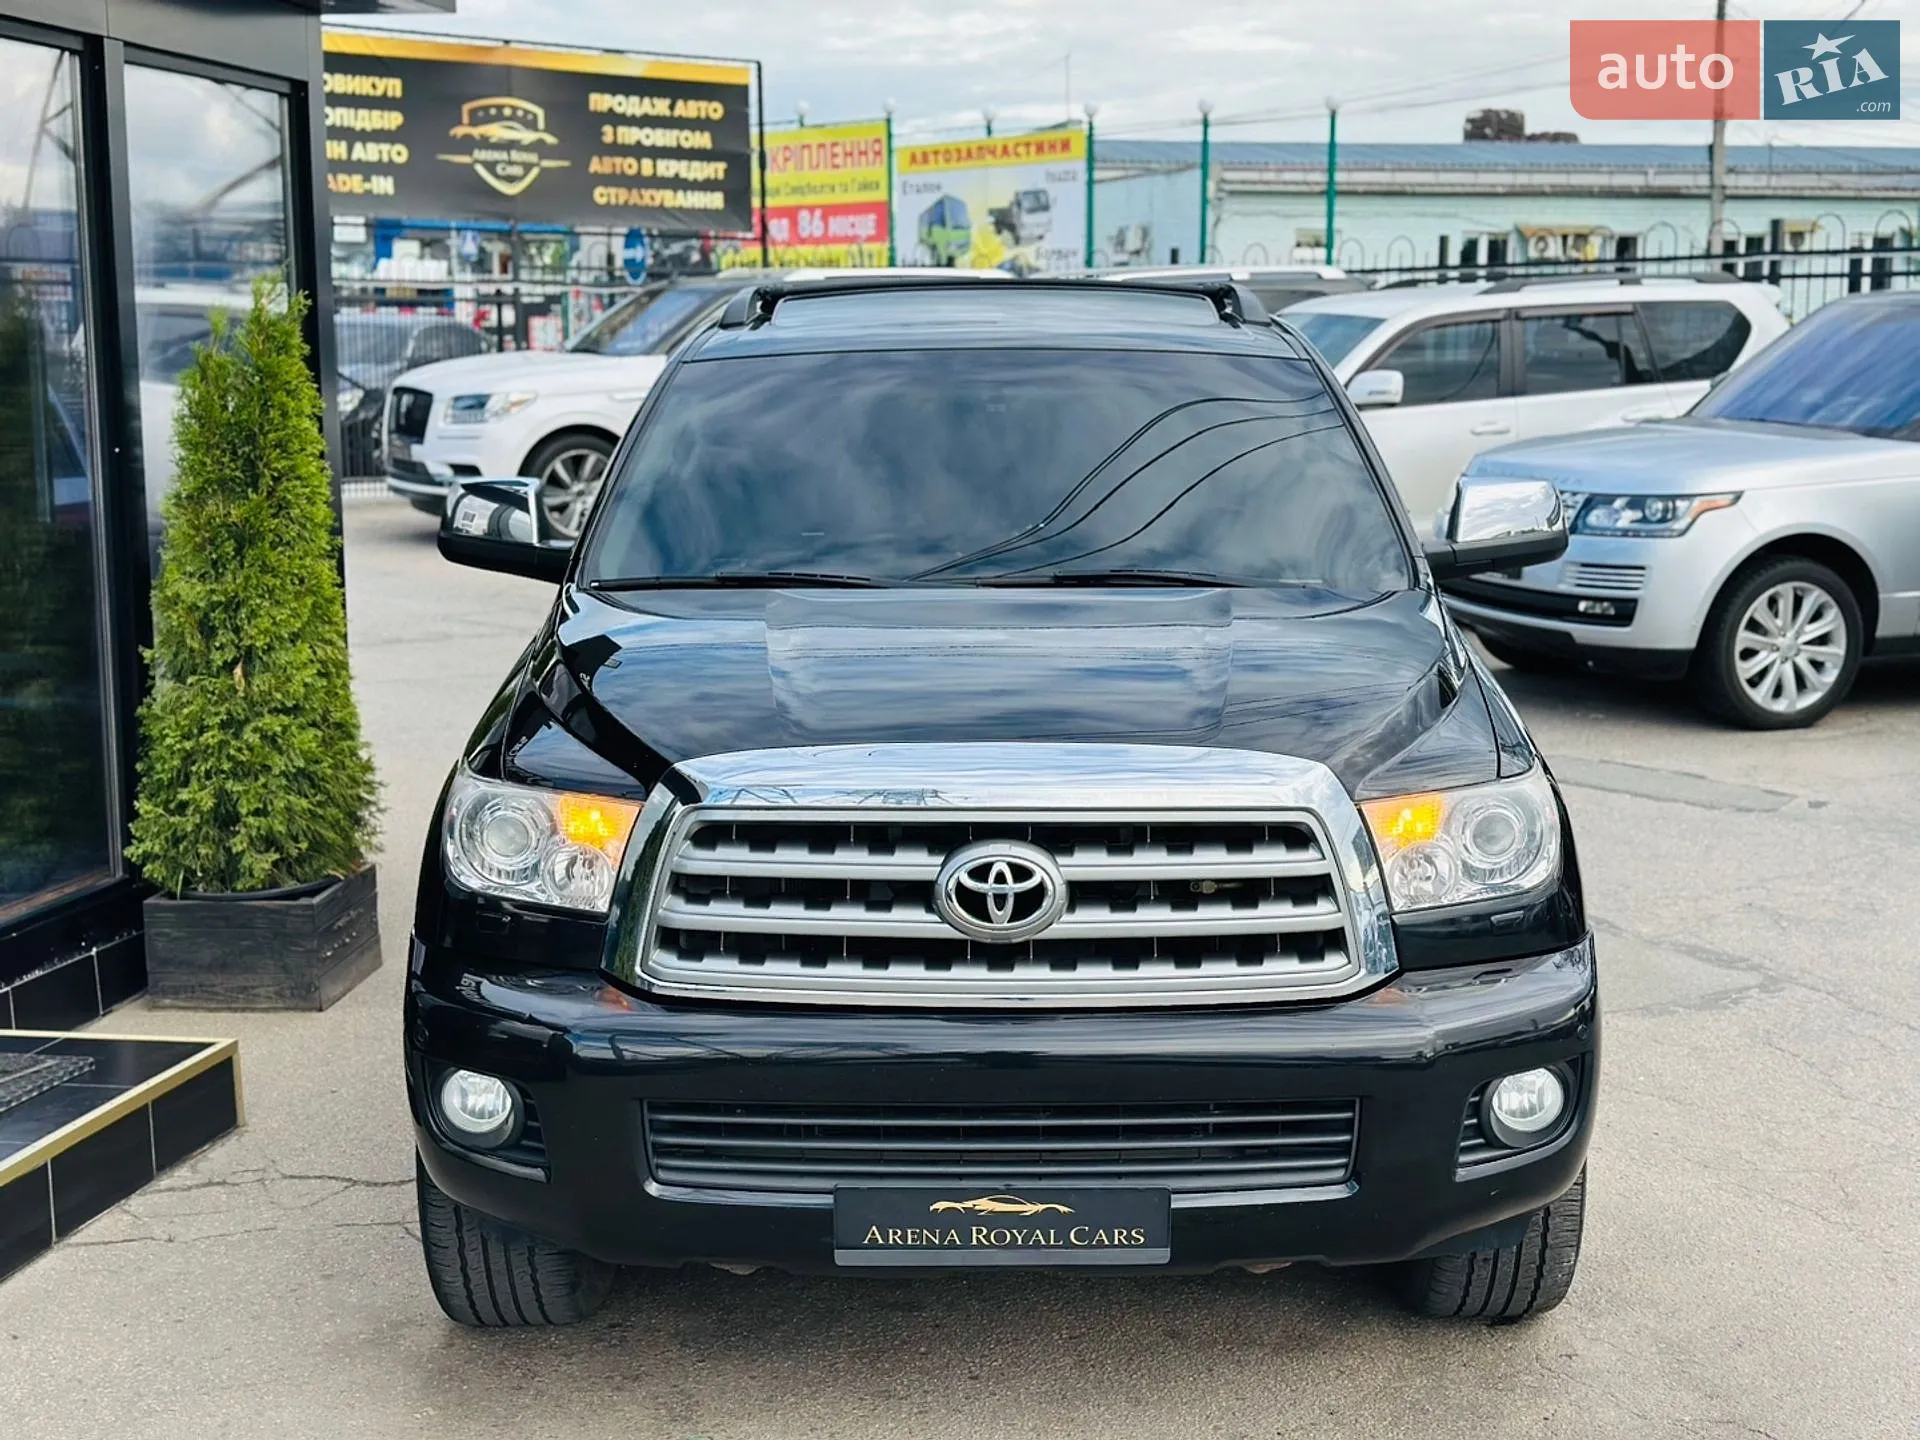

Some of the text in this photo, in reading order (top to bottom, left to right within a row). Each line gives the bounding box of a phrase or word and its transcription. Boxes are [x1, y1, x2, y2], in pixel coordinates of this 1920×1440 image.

[588, 92, 724, 121] ПРОДАЖ АВТО
[616, 125, 713, 150] ПРОБІГОМ
[351, 141, 409, 164] АВТО
[769, 137, 884, 175] КРІПЛЕННЯ
[908, 137, 1073, 168] АВТОЗАПЧАСТИНИ
[588, 155, 728, 182] АВТО В КРЕДИТ
[592, 186, 725, 210] СТРАХУВАННЯ
[797, 207, 825, 239] 86
[862, 1225, 1146, 1246] ARENA ROYAL CARS
